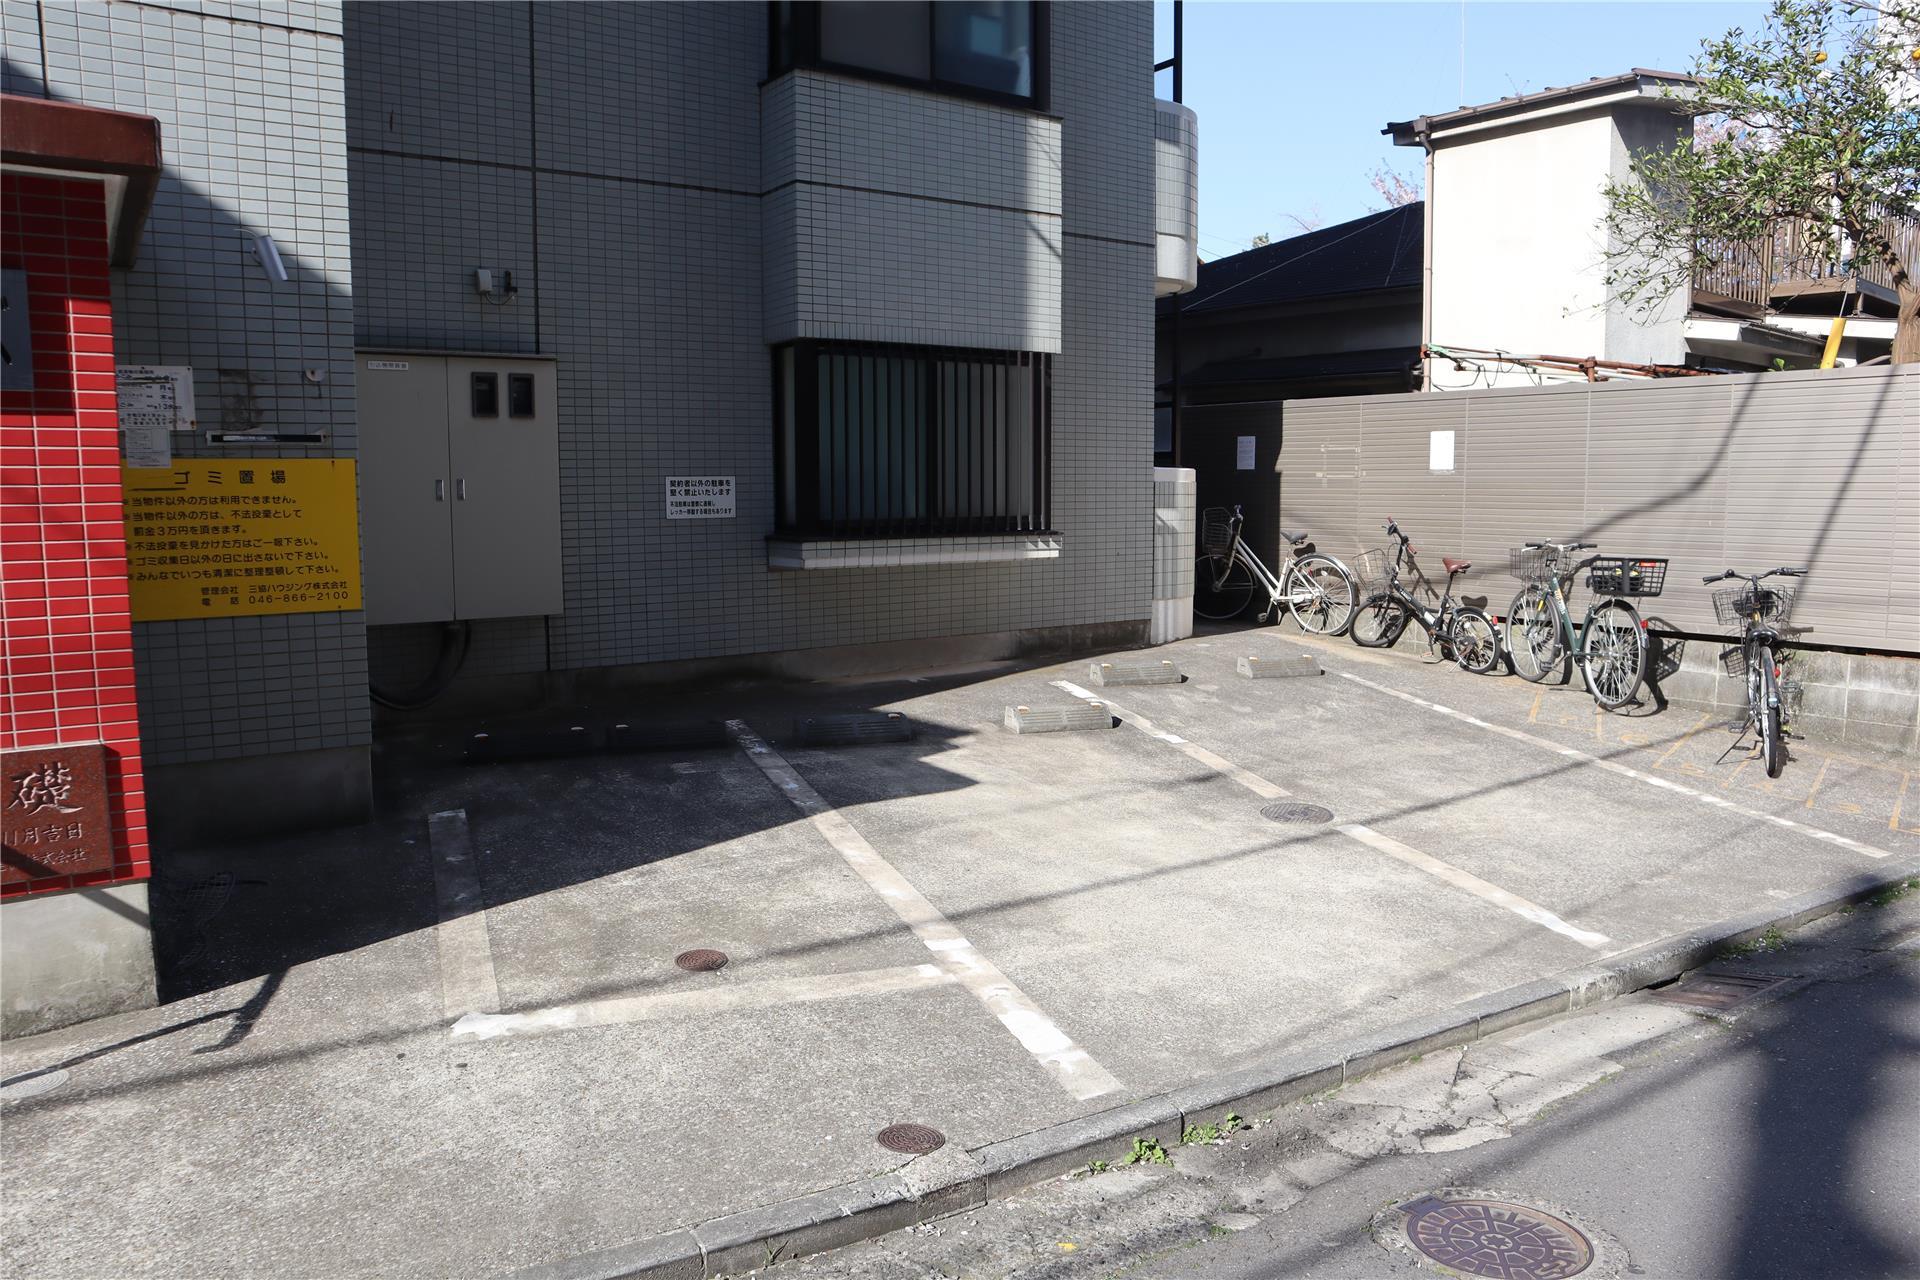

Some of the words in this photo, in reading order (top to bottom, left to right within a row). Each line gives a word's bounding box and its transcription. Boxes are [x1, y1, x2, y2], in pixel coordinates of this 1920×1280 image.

[174, 469, 286, 485] ゴミ置場
[200, 586, 239, 595] 管理会社
[248, 591, 348, 604] 046-866-2100
